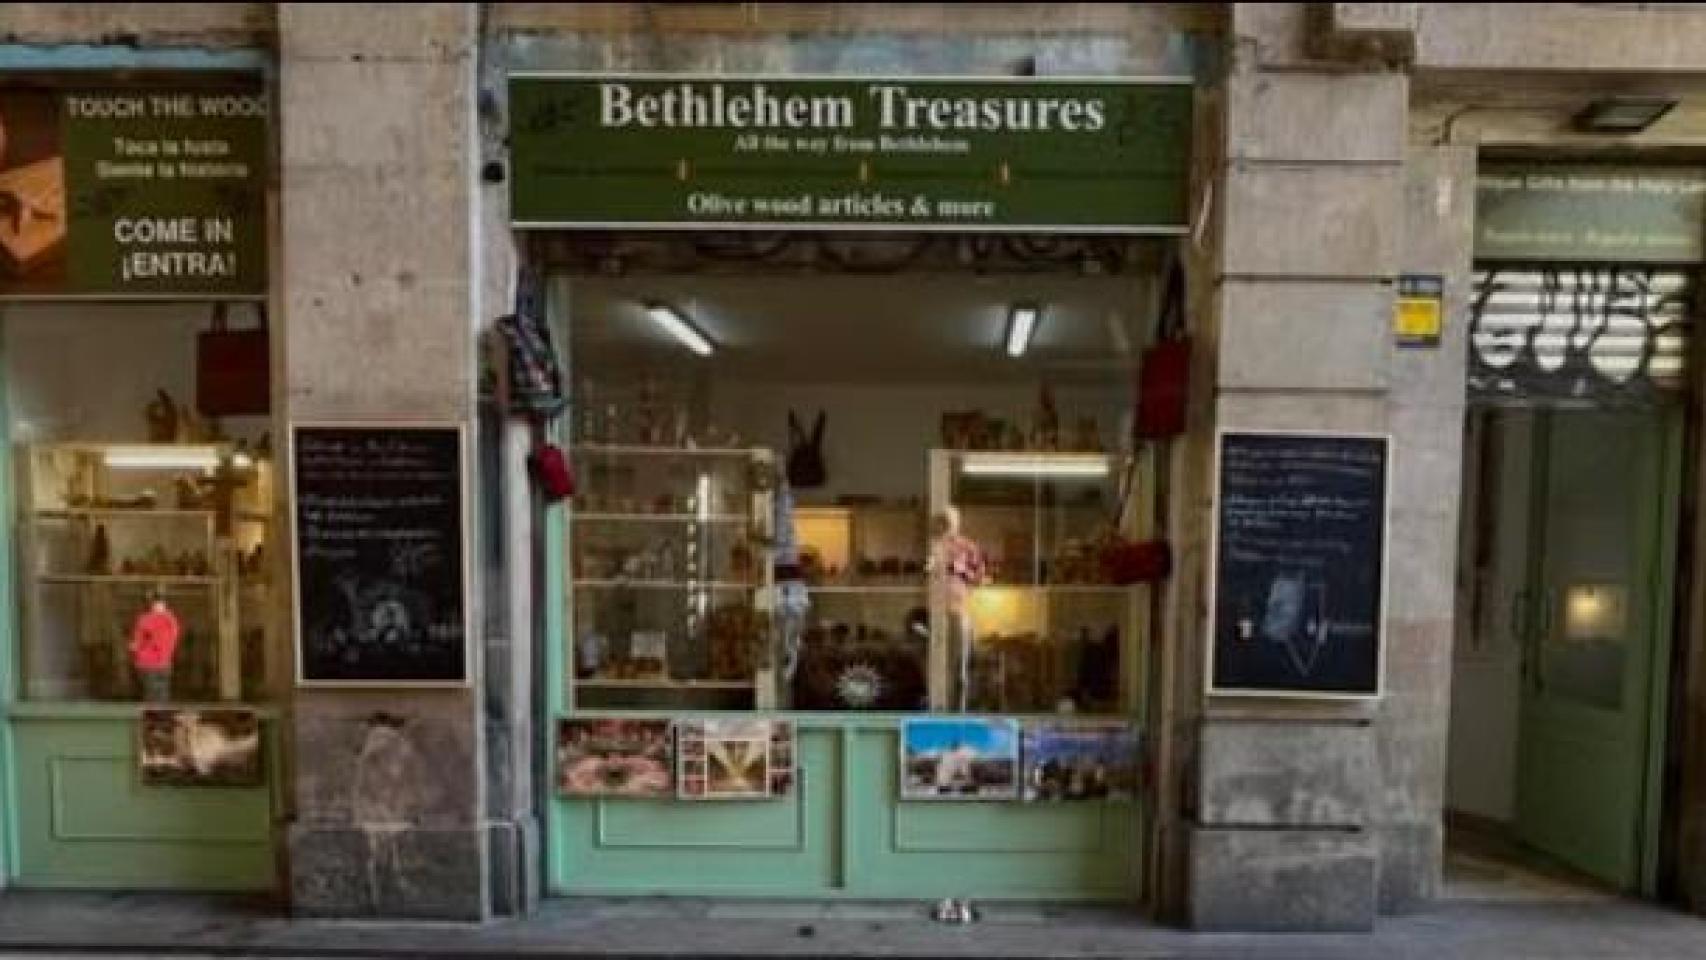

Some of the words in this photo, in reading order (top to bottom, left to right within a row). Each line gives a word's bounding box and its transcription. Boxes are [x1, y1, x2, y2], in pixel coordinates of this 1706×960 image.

[68, 96, 144, 117] TOUCH
[152, 96, 194, 117] THE
[602, 83, 853, 128] Bethlehem
[870, 85, 1105, 131] Treasures
[734, 134, 759, 152] All
[687, 192, 744, 214] Olive
[753, 193, 811, 215] wood
[818, 192, 904, 217] articles
[909, 195, 930, 217] &
[937, 201, 995, 217] more
[113, 217, 198, 243] COME
[204, 217, 234, 243] IN
[122, 251, 236, 281] ¡ENTRA!
